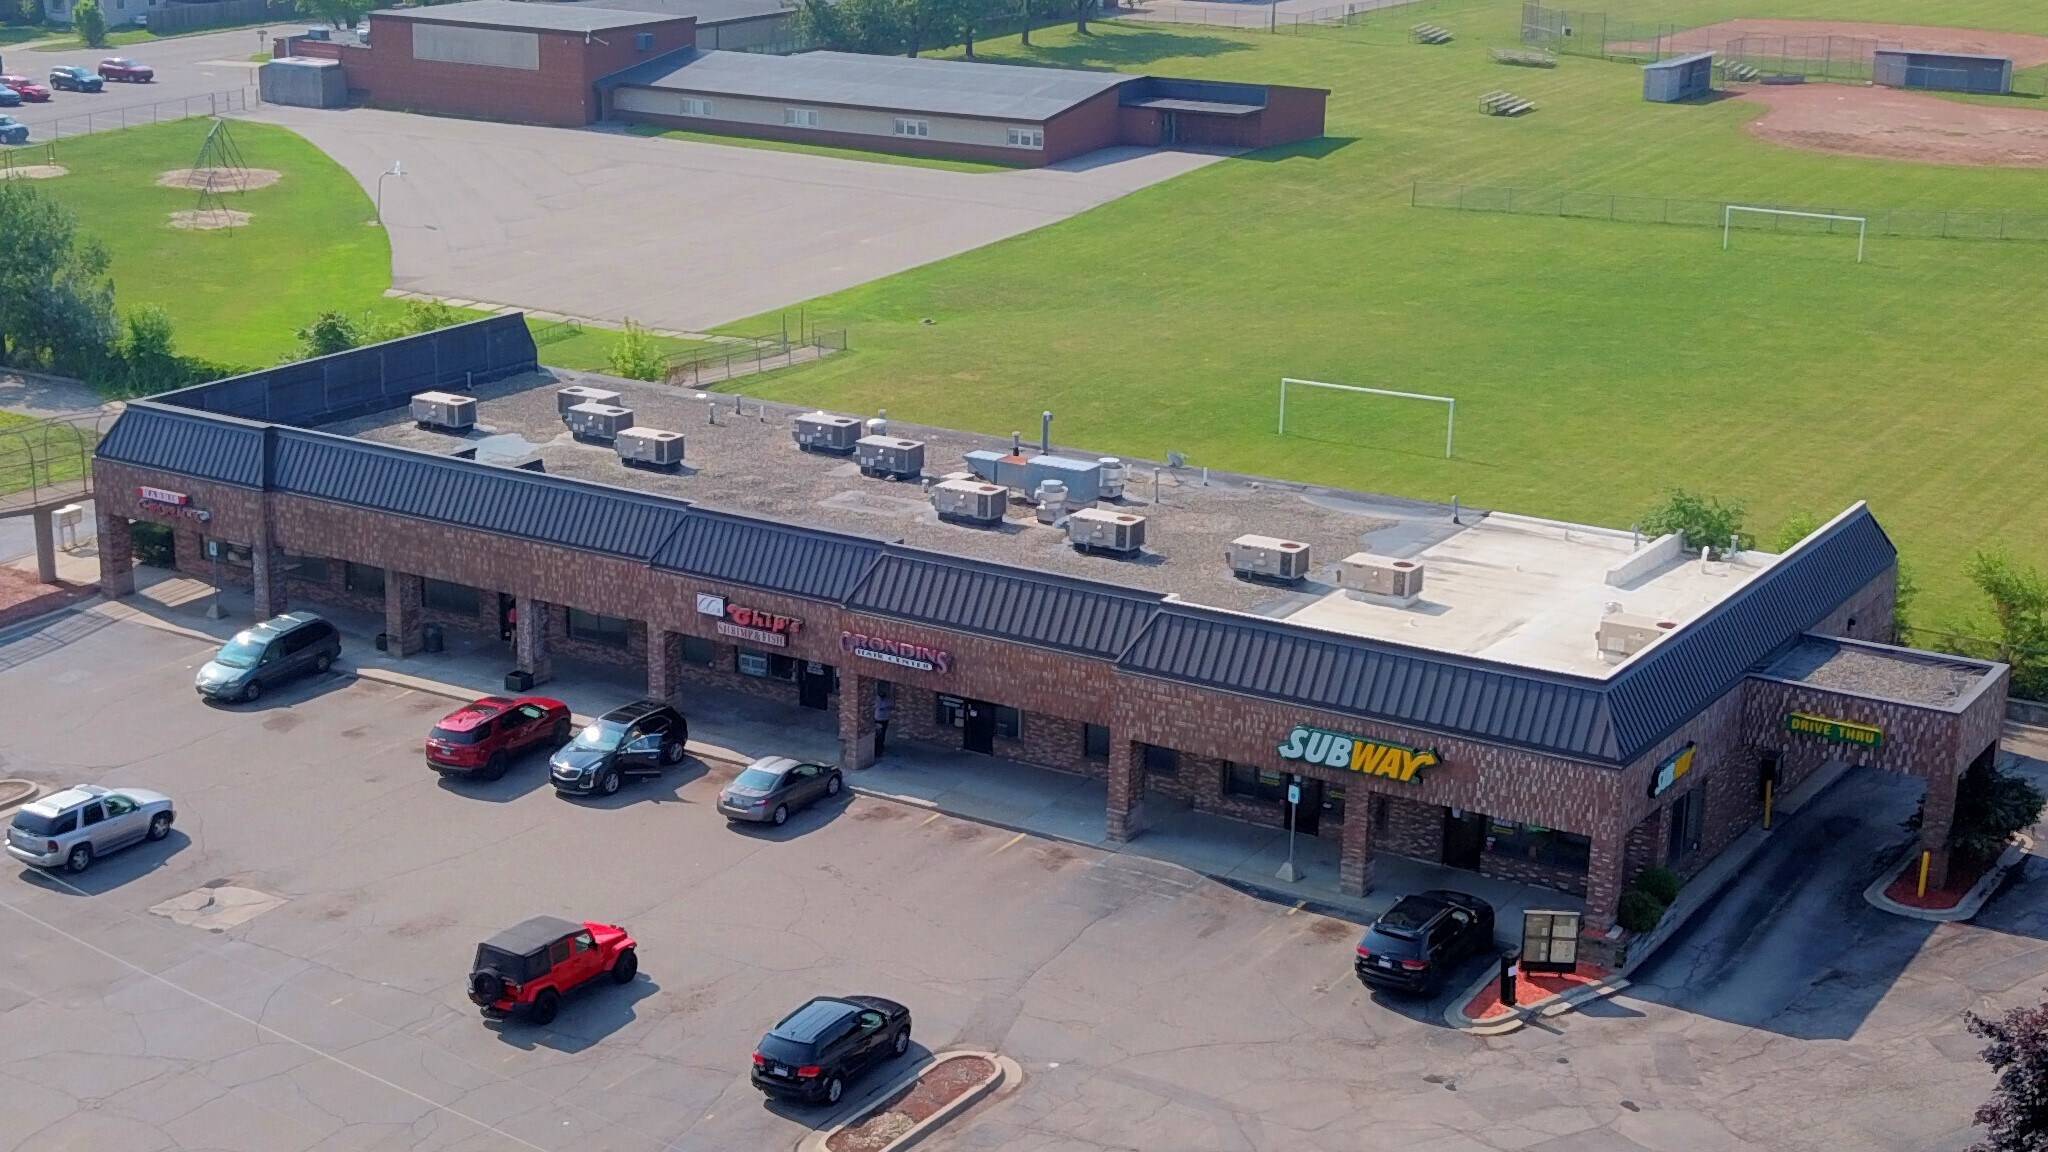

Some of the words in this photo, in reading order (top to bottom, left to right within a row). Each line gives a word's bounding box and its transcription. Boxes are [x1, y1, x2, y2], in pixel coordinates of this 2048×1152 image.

[857, 649, 883, 662] HAIR
[887, 655, 930, 670] CENTER
[1791, 717, 1832, 735] DRIVE
[1838, 726, 1875, 744] THRU
[1278, 727, 1437, 782] SUBWAY
